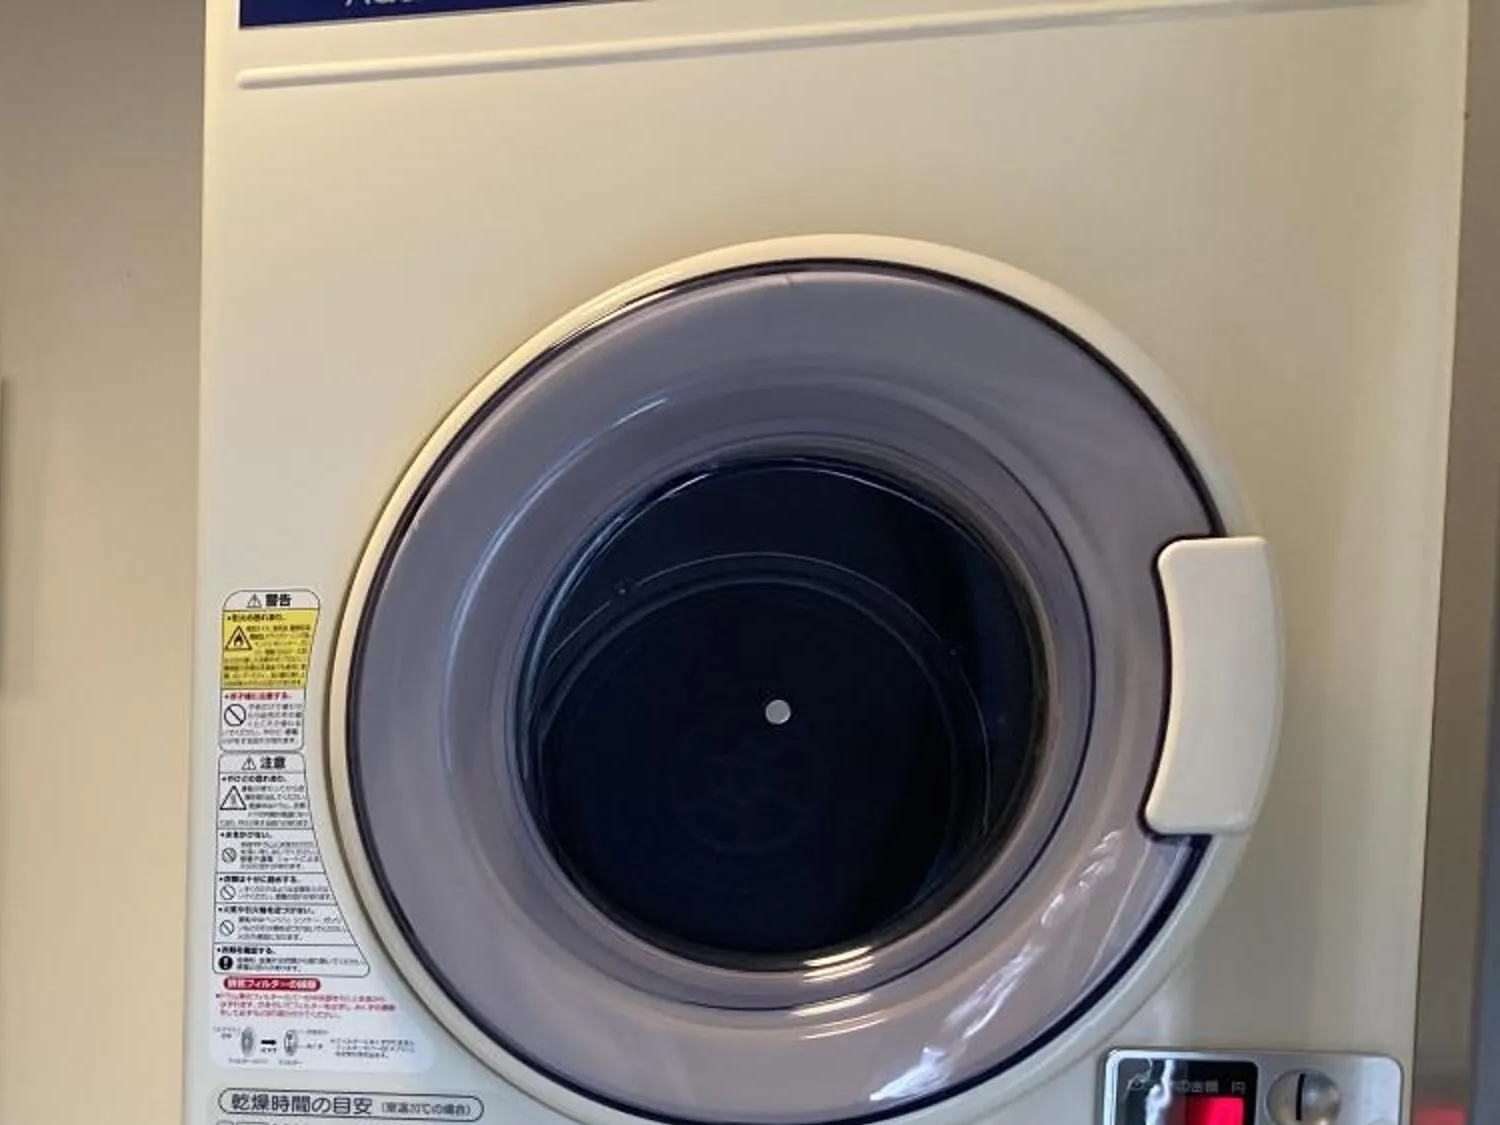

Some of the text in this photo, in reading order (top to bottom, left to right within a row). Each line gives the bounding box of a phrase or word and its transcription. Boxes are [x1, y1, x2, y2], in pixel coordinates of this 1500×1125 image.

[265, 593, 292, 607] 警告
[260, 756, 286, 769] 注意
[231, 1093, 374, 1115] 乾燥時間の目安
